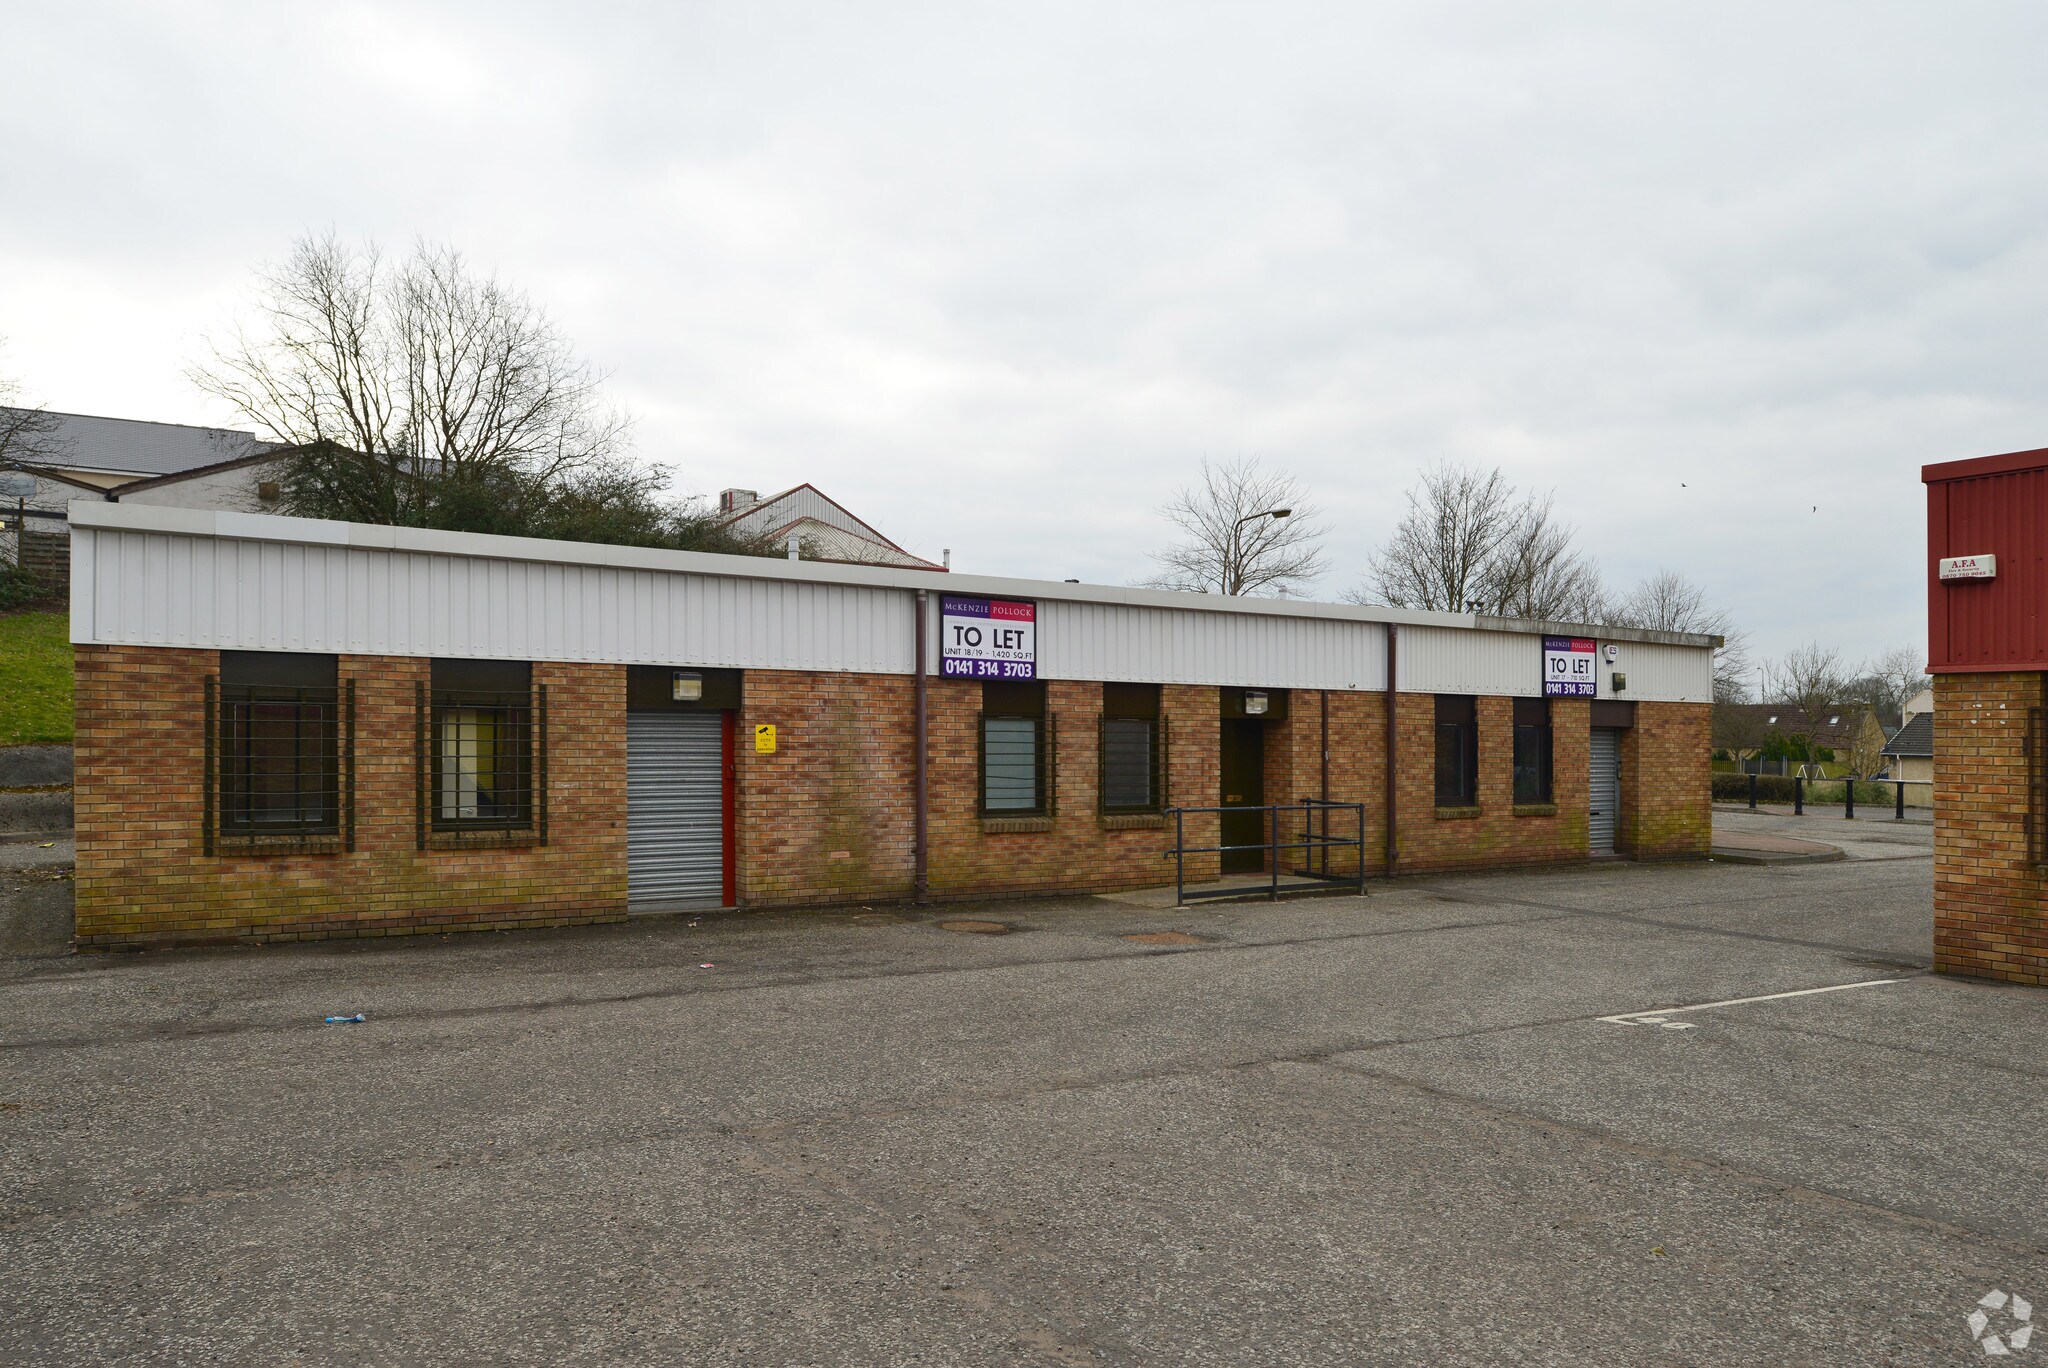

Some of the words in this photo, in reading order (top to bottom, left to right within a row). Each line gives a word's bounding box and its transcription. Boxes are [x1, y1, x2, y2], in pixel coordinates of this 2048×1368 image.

[1951, 559, 1976, 568] A.F.A
[993, 606, 1032, 617] POLLOCK
[953, 625, 982, 647] TO
[993, 628, 1024, 650] LET
[945, 647, 961, 655] UNIT
[964, 648, 982, 657] 18/19
[992, 650, 1010, 659] 1,420
[945, 659, 973, 675] 0141
[977, 660, 999, 676] 314
[1003, 662, 1032, 678] 3703
[1550, 658, 1567, 673] TO
[1572, 659, 1590, 674] LET
[1546, 683, 1562, 694] 0141
[1564, 683, 1576, 694] 314
[1578, 684, 1594, 695] 3703
